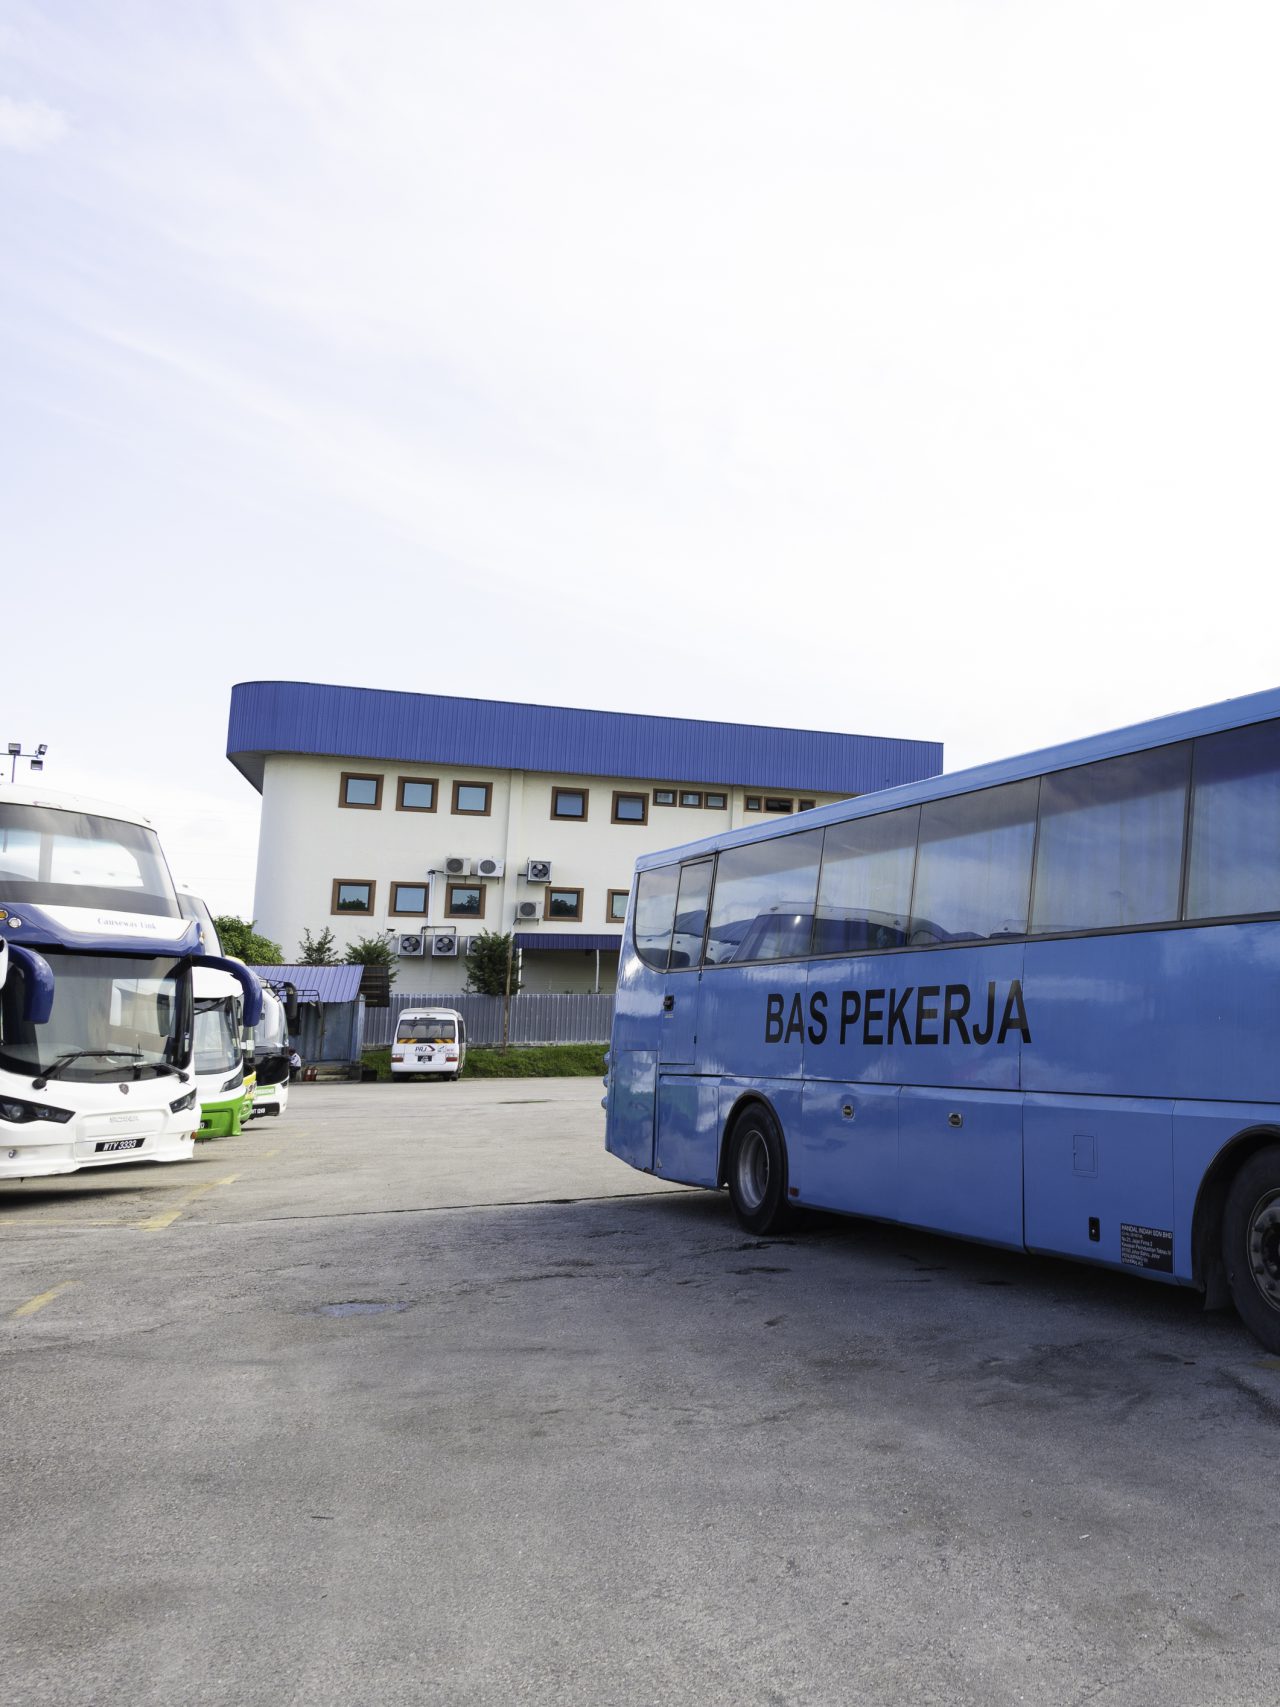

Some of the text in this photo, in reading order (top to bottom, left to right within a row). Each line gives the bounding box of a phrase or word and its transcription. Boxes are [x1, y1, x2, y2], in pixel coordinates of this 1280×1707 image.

[97, 916, 137, 928] Causeway
[765, 980, 1032, 1045] BAS PEKERJA
[103, 1139, 137, 1151] WTY 3333
